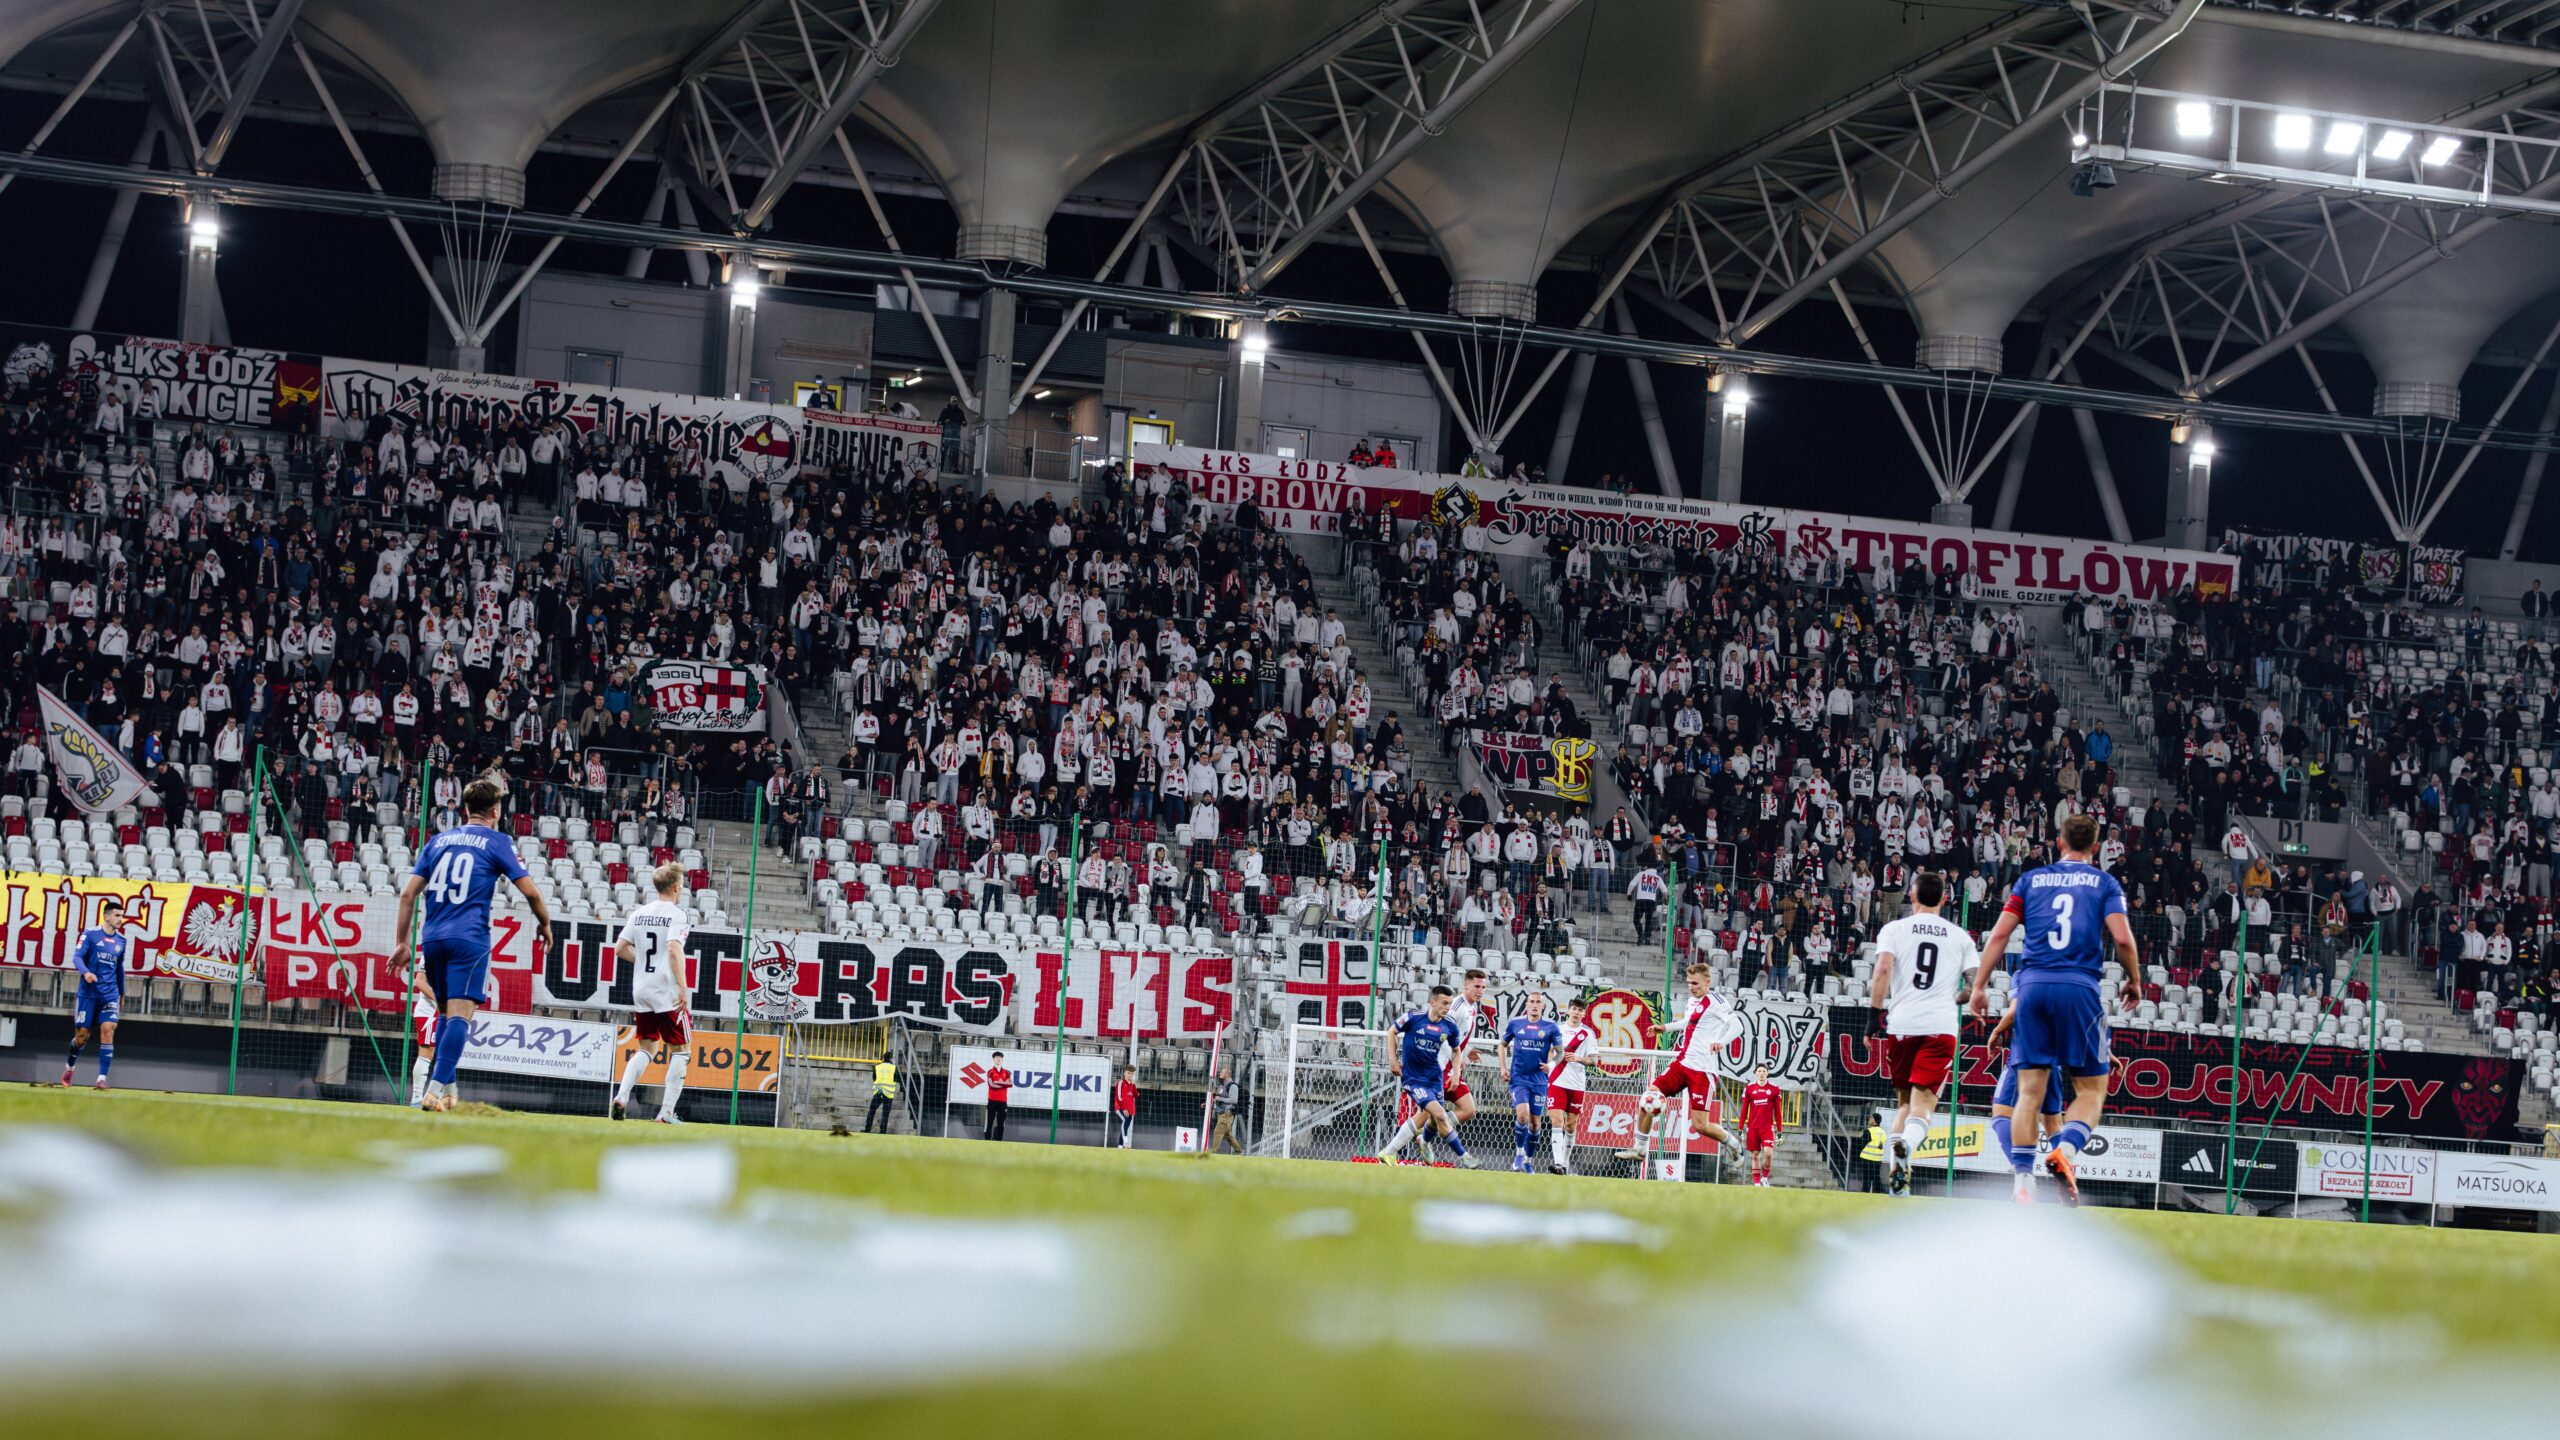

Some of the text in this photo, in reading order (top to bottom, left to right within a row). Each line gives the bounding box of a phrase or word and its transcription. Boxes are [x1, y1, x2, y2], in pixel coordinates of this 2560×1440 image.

[114, 345, 277, 388] ŁKS ŁÓDŹ
[1202, 453, 1347, 482] ŁKS ŁÓDŹ
[1557, 494, 1566, 502] CO
[1644, 501, 1653, 509] CO
[1666, 503, 1677, 512] NIE
[1841, 528, 2189, 601] TEOFILÓW
[2413, 545, 2465, 565] DAREK
[2017, 591, 2056, 602] GDZIE
[656, 670, 691, 679] 1908
[656, 684, 698, 713] ŁKS
[2278, 819, 2303, 843] D1
[429, 852, 475, 905] 49
[2031, 871, 2100, 888] GRUDZIŃSKI
[270, 898, 364, 947] ŁKS
[1912, 924, 1948, 938] ARASA
[2047, 893, 2074, 950] 3
[645, 932, 657, 973] 2
[1913, 942, 1938, 990] 9
[1034, 950, 1233, 1034] ŁKS
[1518, 1039, 1545, 1048] VOTUM
[1719, 998, 1825, 1085] ÓDŹ
[493, 1053, 519, 1064] TKANIN
[521, 1057, 577, 1069] BAWEŁNIANYCH
[698, 1046, 772, 1072] ŁÓDŹ
[1010, 1070, 1103, 1093] UZUKI
[1918, 1130, 1977, 1152] Kramel
[2113, 1143, 2148, 1151] PODLASIE
[2323, 1150, 2429, 1175] COSINUS
[2127, 1170, 2152, 1179] 24A
[2327, 1177, 2407, 1191] BEZPŁATE SZKOŁY
[2457, 1175, 2547, 1195] MATSUOKA
